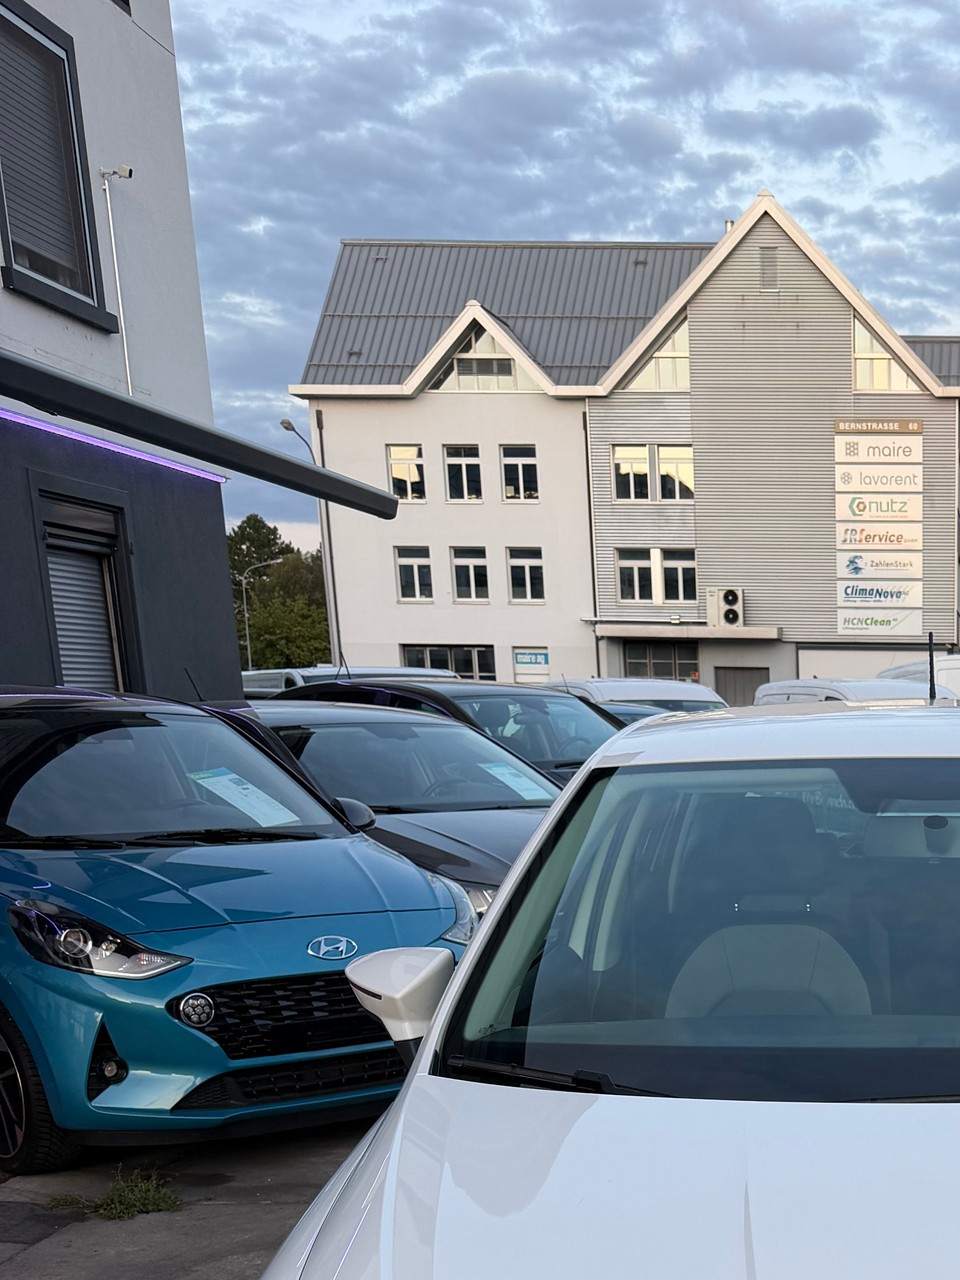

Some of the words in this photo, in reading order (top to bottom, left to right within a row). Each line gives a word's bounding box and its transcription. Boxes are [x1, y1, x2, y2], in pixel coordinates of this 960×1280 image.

[839, 422, 899, 430] BERNSTRASSE
[867, 441, 912, 457] maire
[859, 471, 918, 486] lavorent
[868, 498, 908, 513] nutz
[844, 585, 903, 599] ClimaNova
[843, 617, 892, 626] HCNClean
